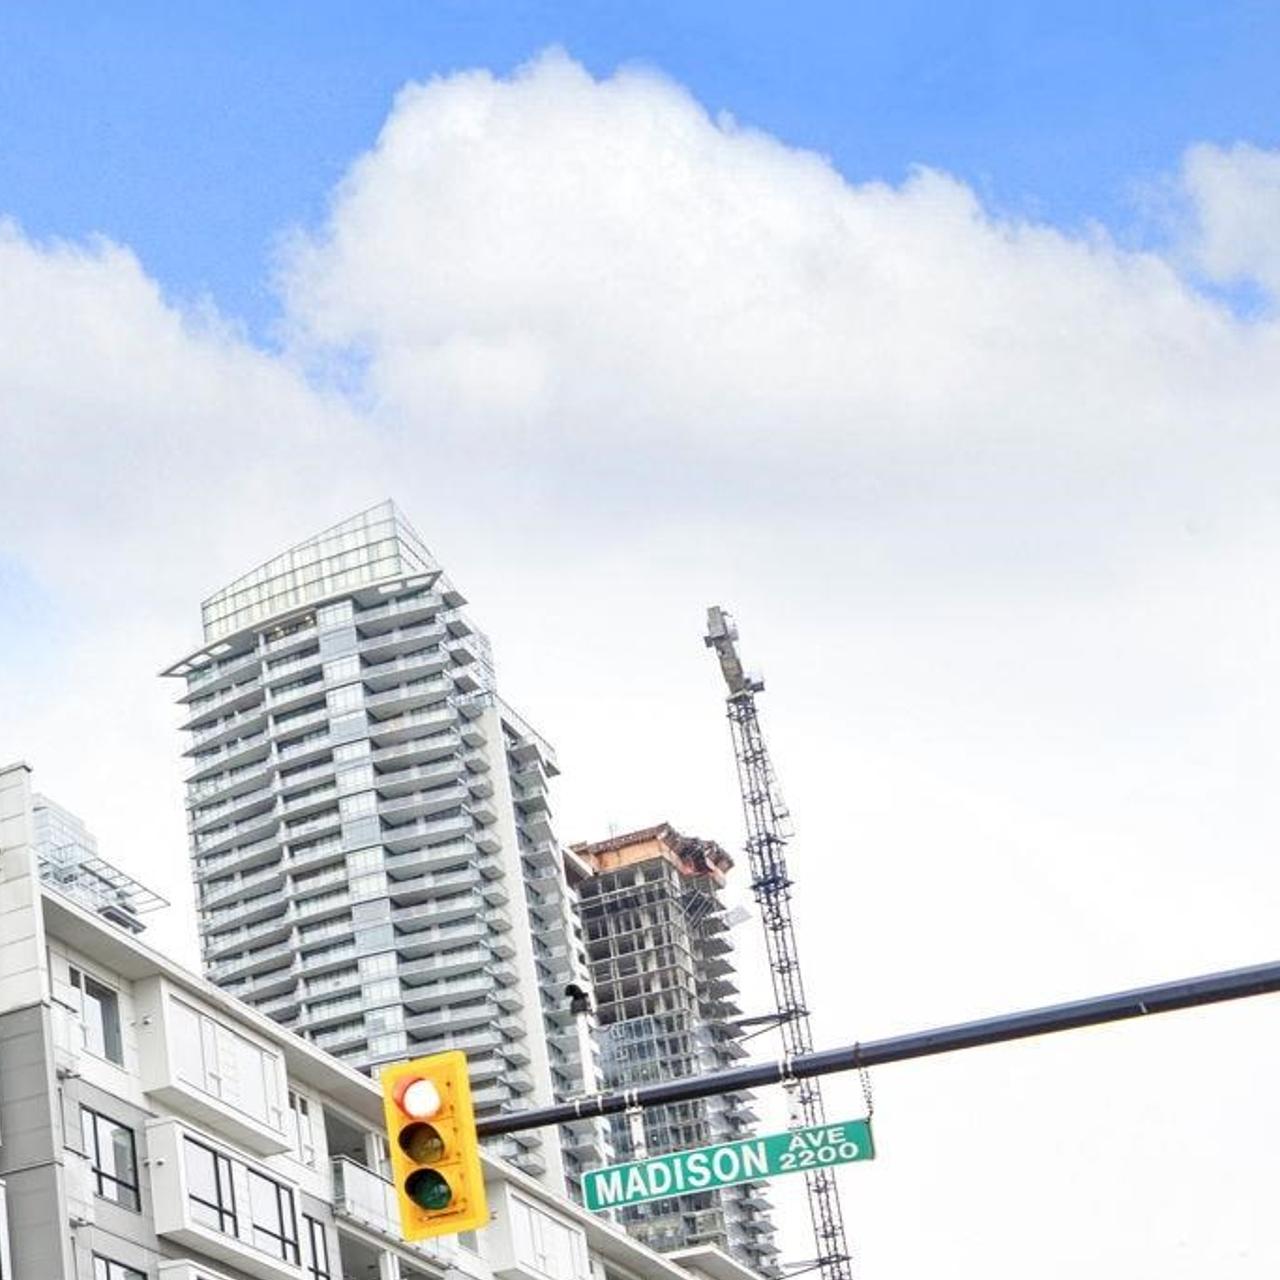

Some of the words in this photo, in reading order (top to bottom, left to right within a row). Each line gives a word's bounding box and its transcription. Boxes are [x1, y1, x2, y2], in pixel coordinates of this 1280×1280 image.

[595, 1142, 768, 1206] MADISON
[788, 1126, 846, 1153] AVE
[779, 1142, 859, 1171] 2200
